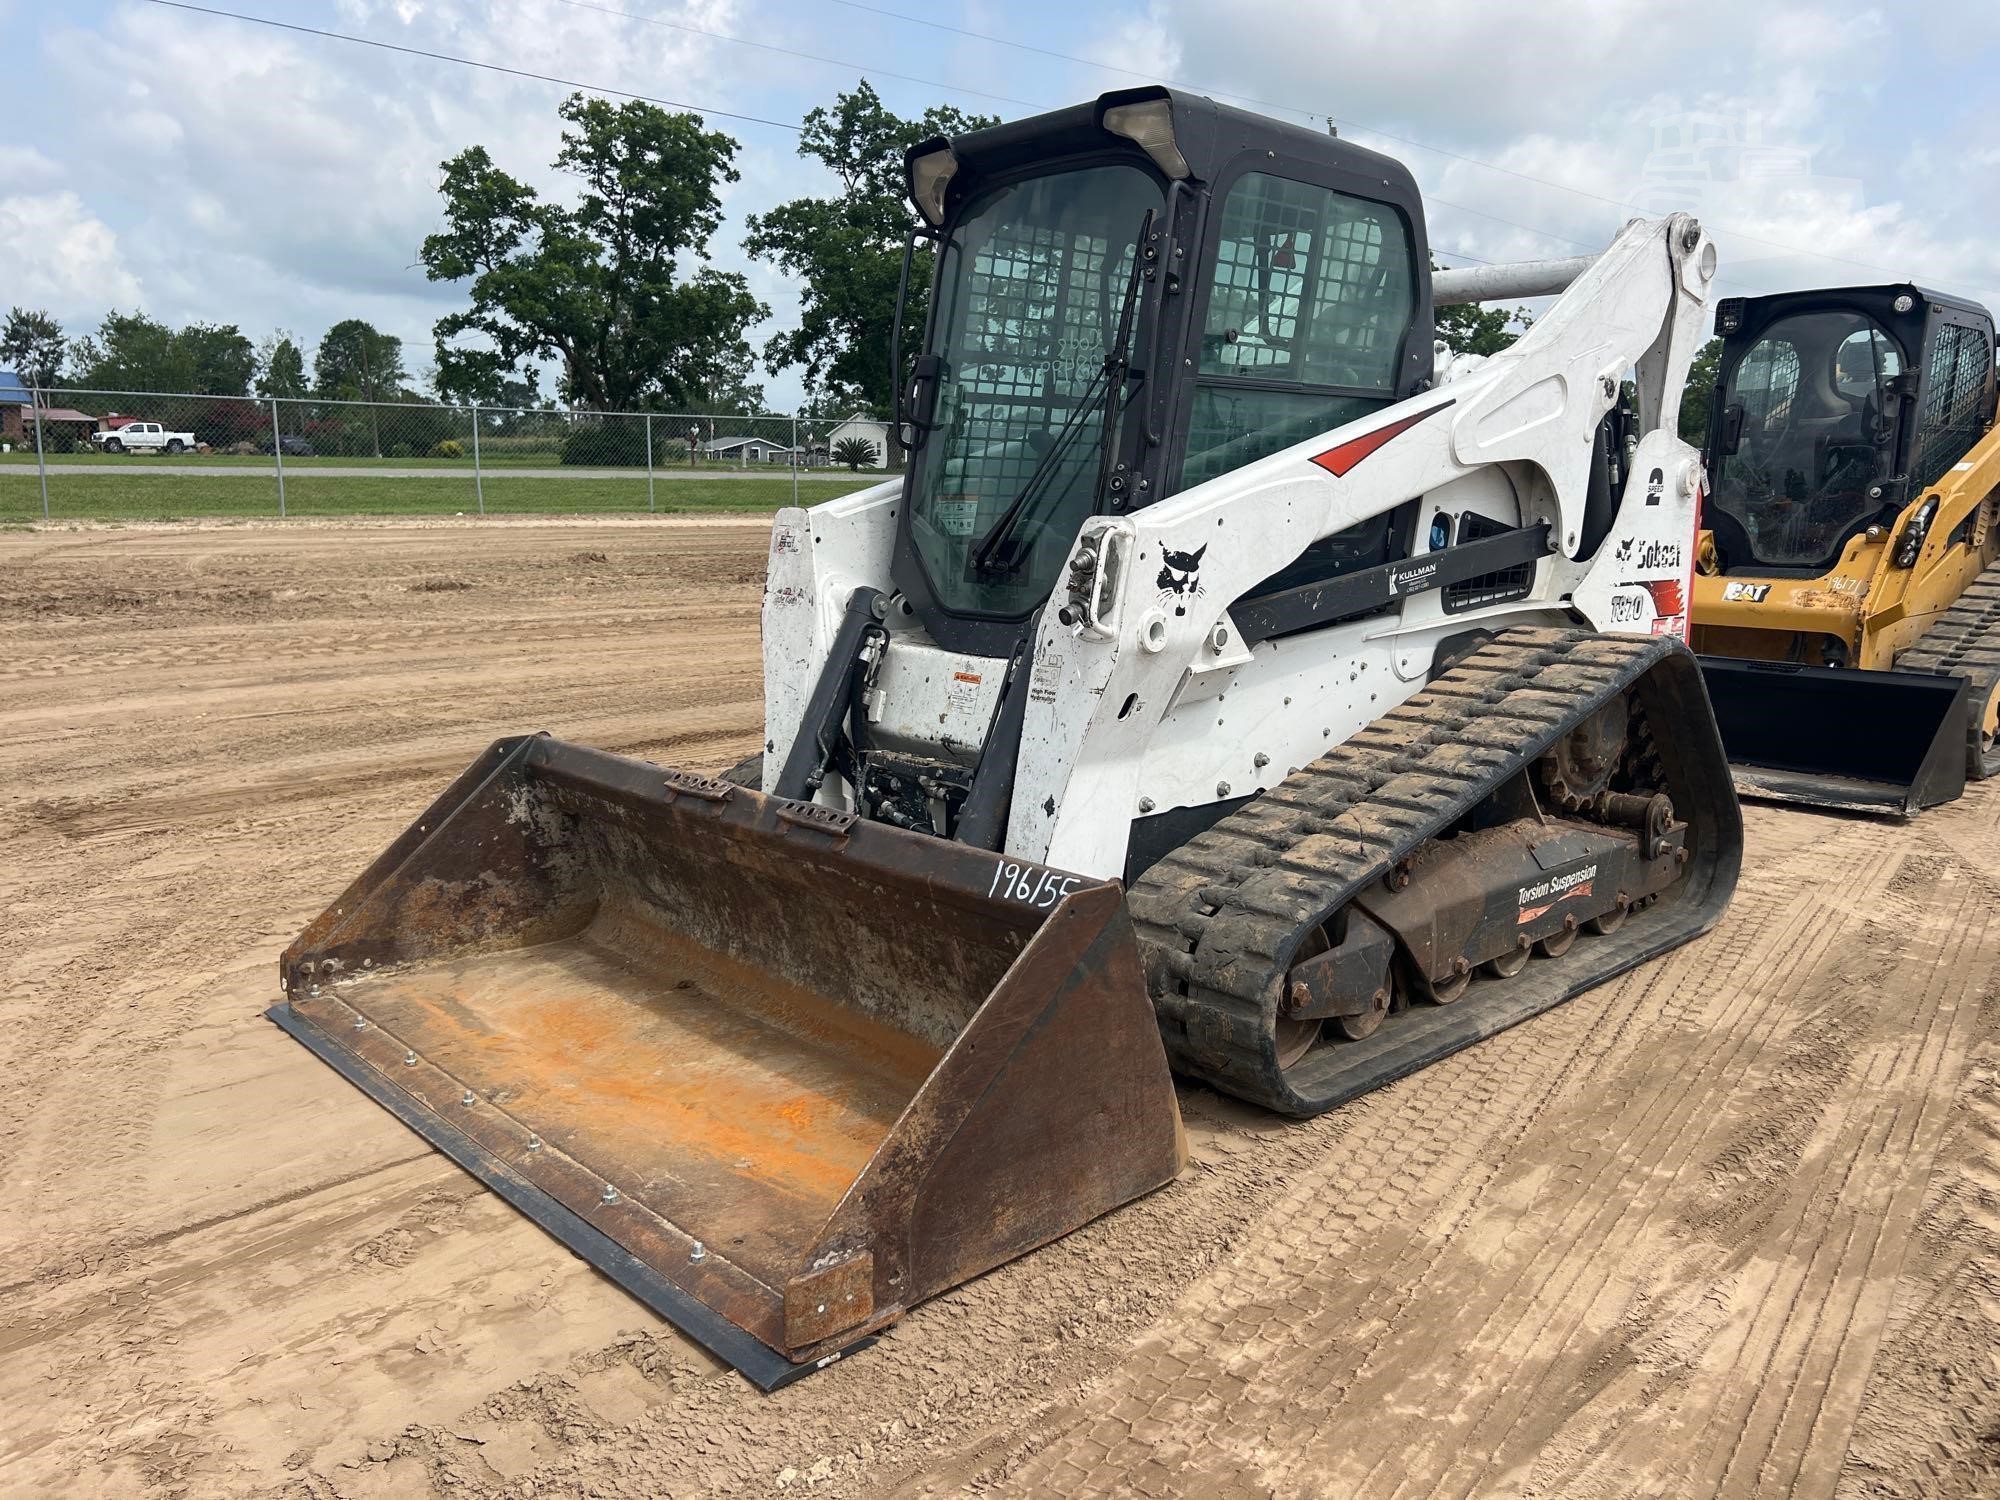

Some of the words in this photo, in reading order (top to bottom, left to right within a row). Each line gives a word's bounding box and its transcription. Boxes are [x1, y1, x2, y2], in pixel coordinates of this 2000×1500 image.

[1647, 484, 1664, 493] SPEED
[1398, 563, 1437, 581] KULLMAN
[1722, 581, 1772, 603] CAT
[1825, 577, 1862, 592] 196171
[1518, 882, 1549, 905] Torsion
[1549, 865, 1597, 893] Suspension
